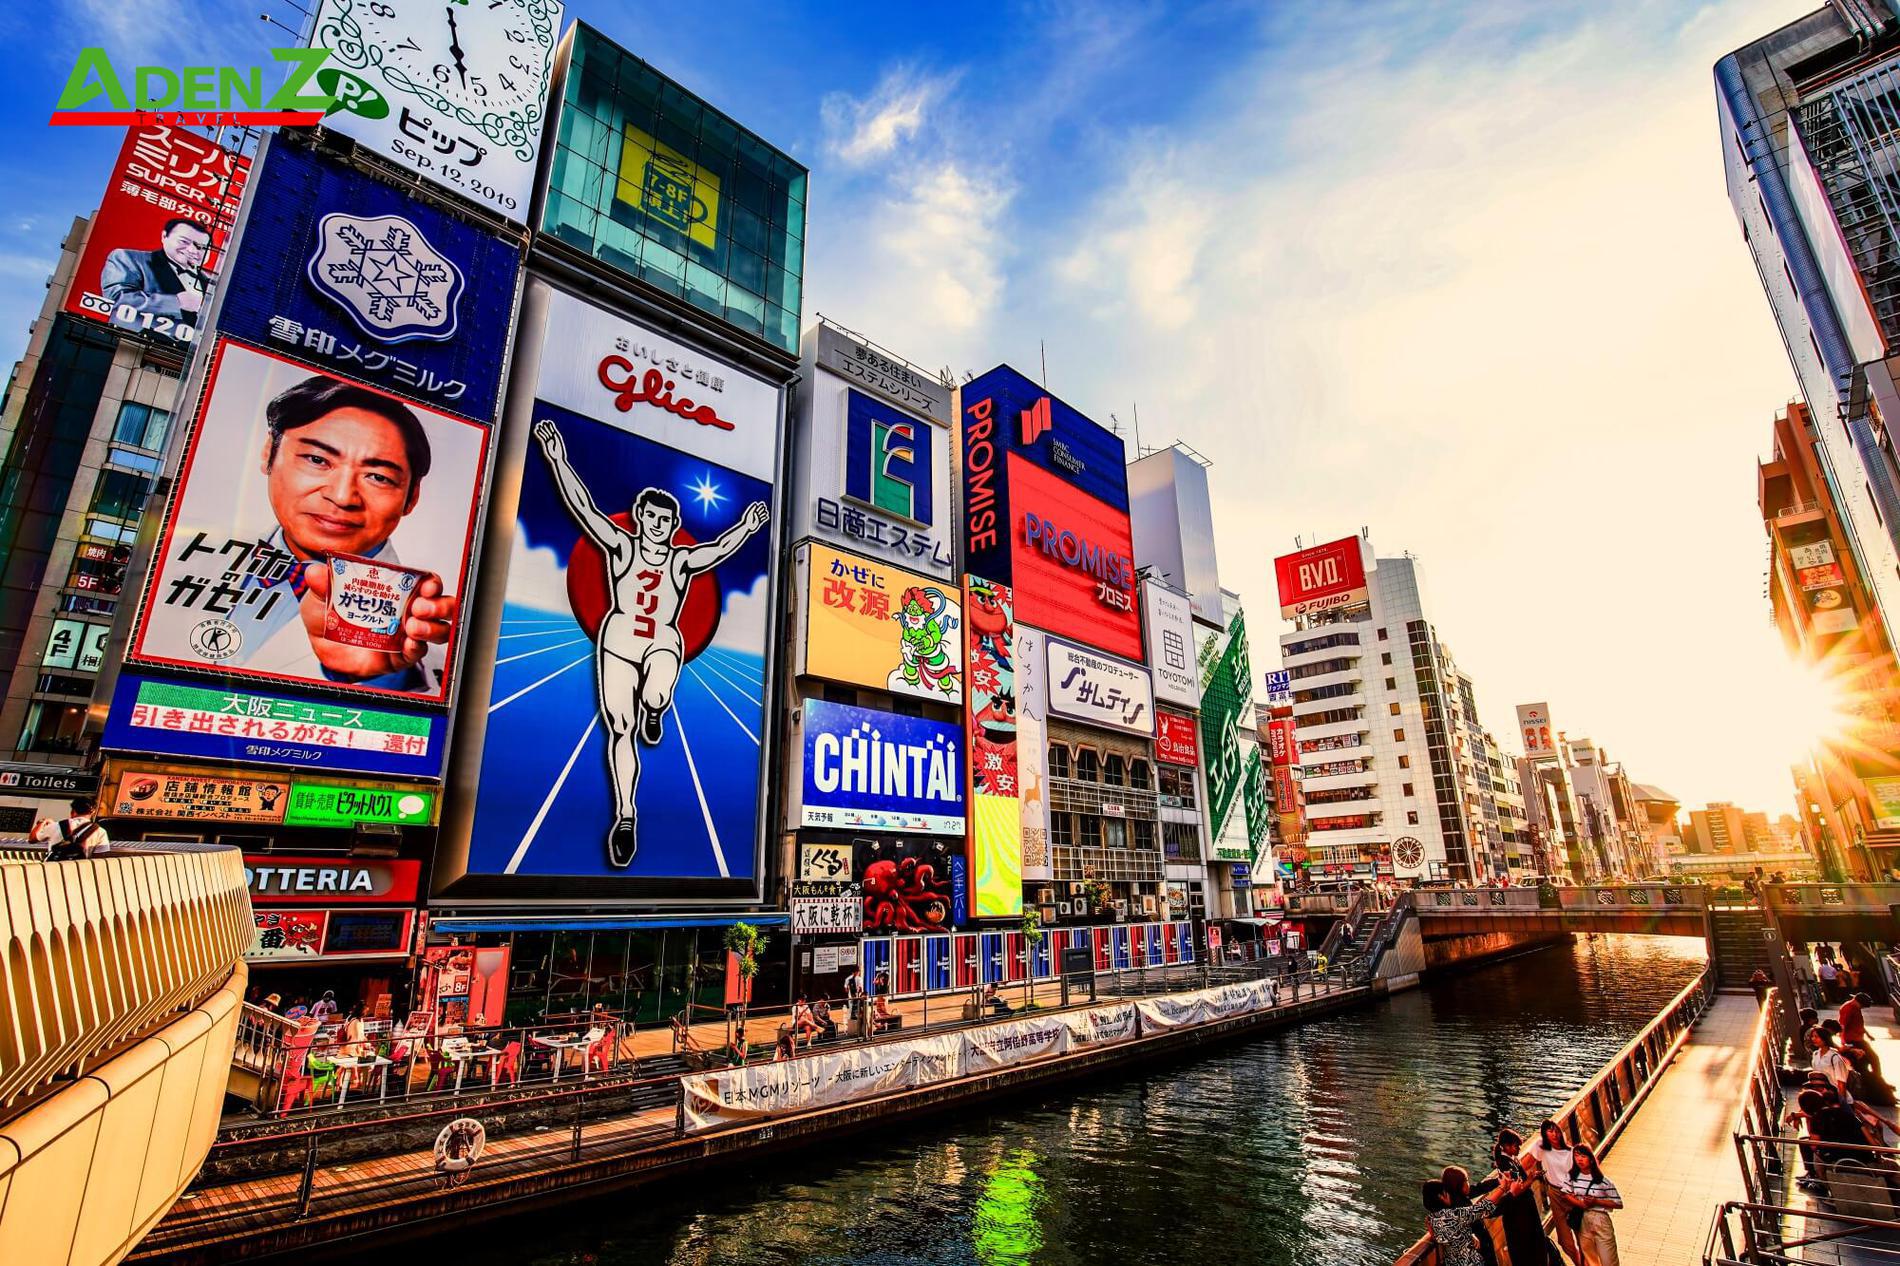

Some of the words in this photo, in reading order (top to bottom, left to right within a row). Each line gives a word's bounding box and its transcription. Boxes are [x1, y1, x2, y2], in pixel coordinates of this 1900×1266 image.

[399, 107, 488, 167] ピップ
[126, 163, 206, 203] SUPER
[391, 138, 435, 169] Sep.
[440, 165, 465, 188] 12,
[470, 179, 517, 211] 2019
[116, 304, 195, 342] 0120
[269, 315, 469, 399] 雪印メグミルク
[616, 337, 725, 393] おいしさと健康
[855, 345, 922, 389] 夢ある住まい
[598, 355, 736, 432] Glico
[843, 359, 933, 414] エステムシリーズ
[967, 397, 996, 553] PROMISE
[818, 497, 952, 567] 日商エステム
[177, 532, 296, 581] トクホ
[1025, 512, 1133, 592] PROMISE
[78, 576, 99, 589] 5F
[831, 558, 886, 589] かぜに
[1299, 557, 1344, 592] B.V.D.
[165, 575, 283, 621] ガセリ
[633, 568, 664, 640] グリコ
[823, 577, 891, 621] 改源
[1096, 582, 1134, 613] プロミス
[1309, 593, 1350, 610] FUJIBO
[347, 611, 385, 625] ヨーグルト
[220, 693, 364, 728] 大阪ニュース
[1076, 680, 1131, 713] サムティ
[245, 745, 323, 761] 雪印メグミルク
[382, 733, 427, 756] 還付
[24, 775, 77, 790] Toilets
[165, 781, 251, 797] 店舗情報館
[135, 808, 173, 817] 株式会社
[336, 791, 393, 816] ピタットハウス
[807, 811, 834, 823] 天気予報
[811, 848, 843, 876] くくる
[796, 904, 853, 928] 大阪に乾杯
[454, 981, 467, 993] 8F
